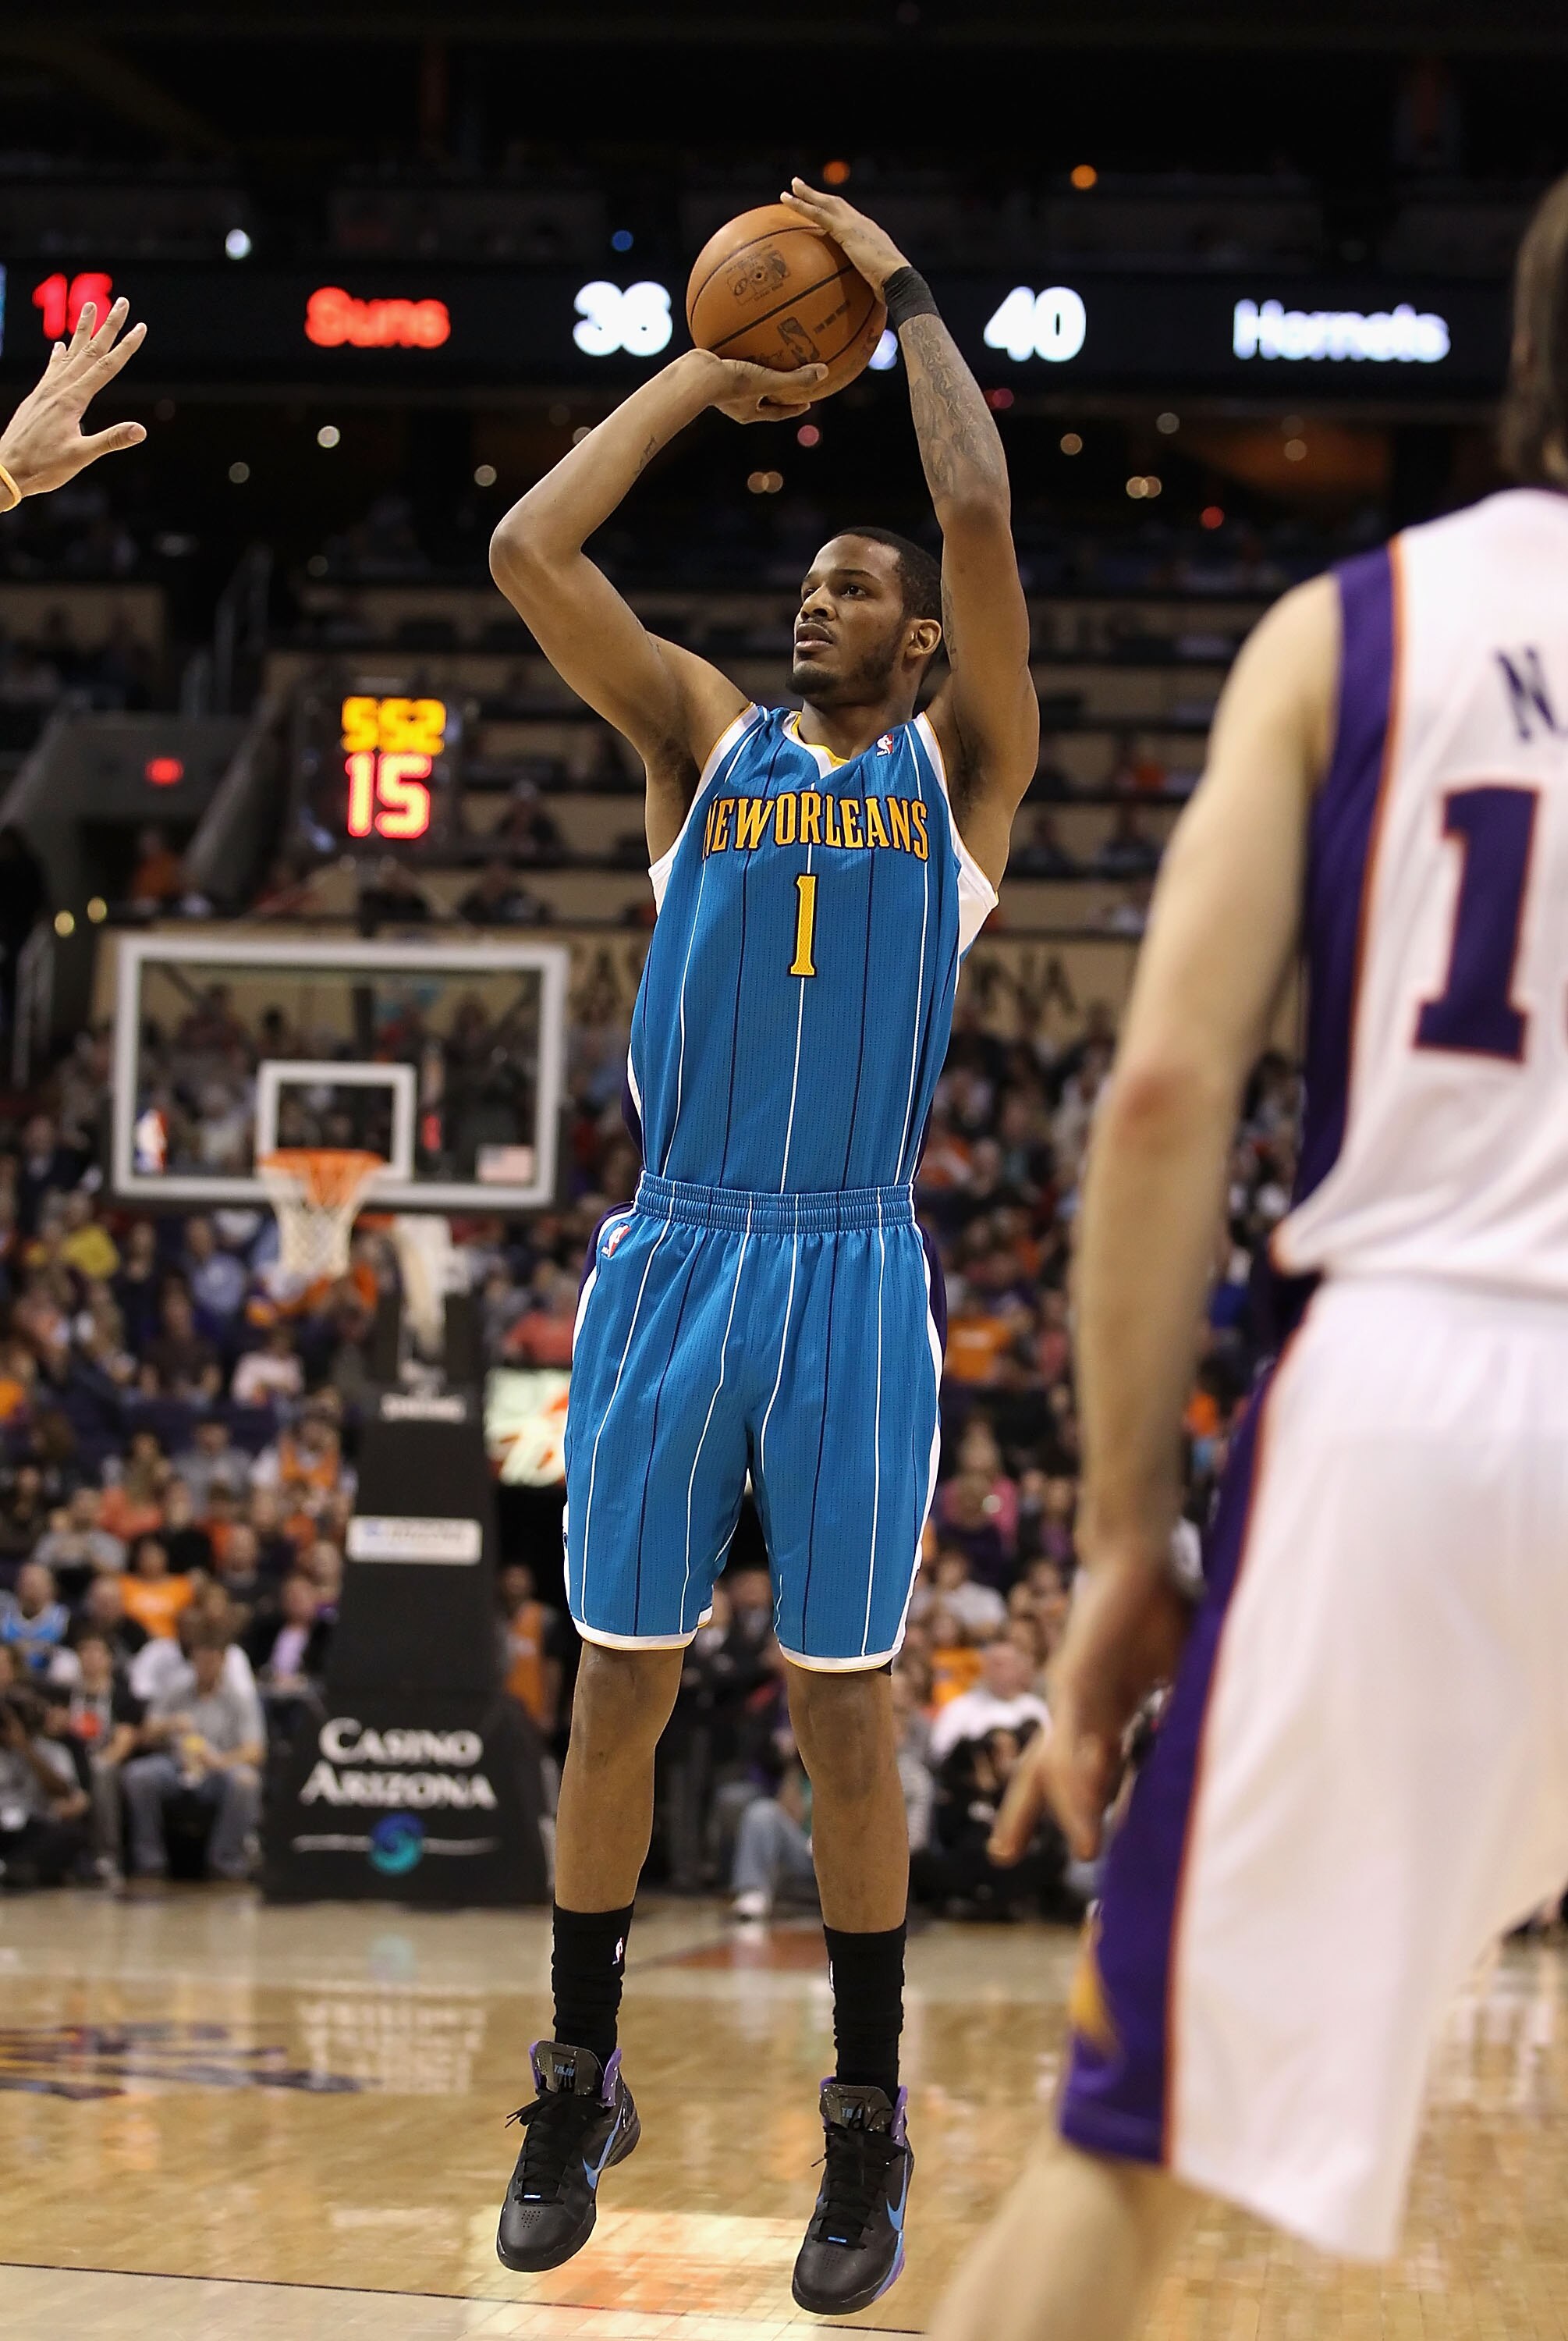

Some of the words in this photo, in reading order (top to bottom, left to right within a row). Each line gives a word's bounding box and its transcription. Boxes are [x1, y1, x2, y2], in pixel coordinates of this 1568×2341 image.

[305, 286, 451, 349] Suns
[984, 286, 1087, 362] 40
[1233, 299, 1451, 364] Hornets
[1493, 641, 1568, 744] N
[345, 751, 433, 840] 15
[786, 872, 818, 979] 1
[1410, 783, 1568, 1067] 1
[318, 1717, 484, 1767] CASINO
[297, 1757, 498, 1810] ARIZONA
